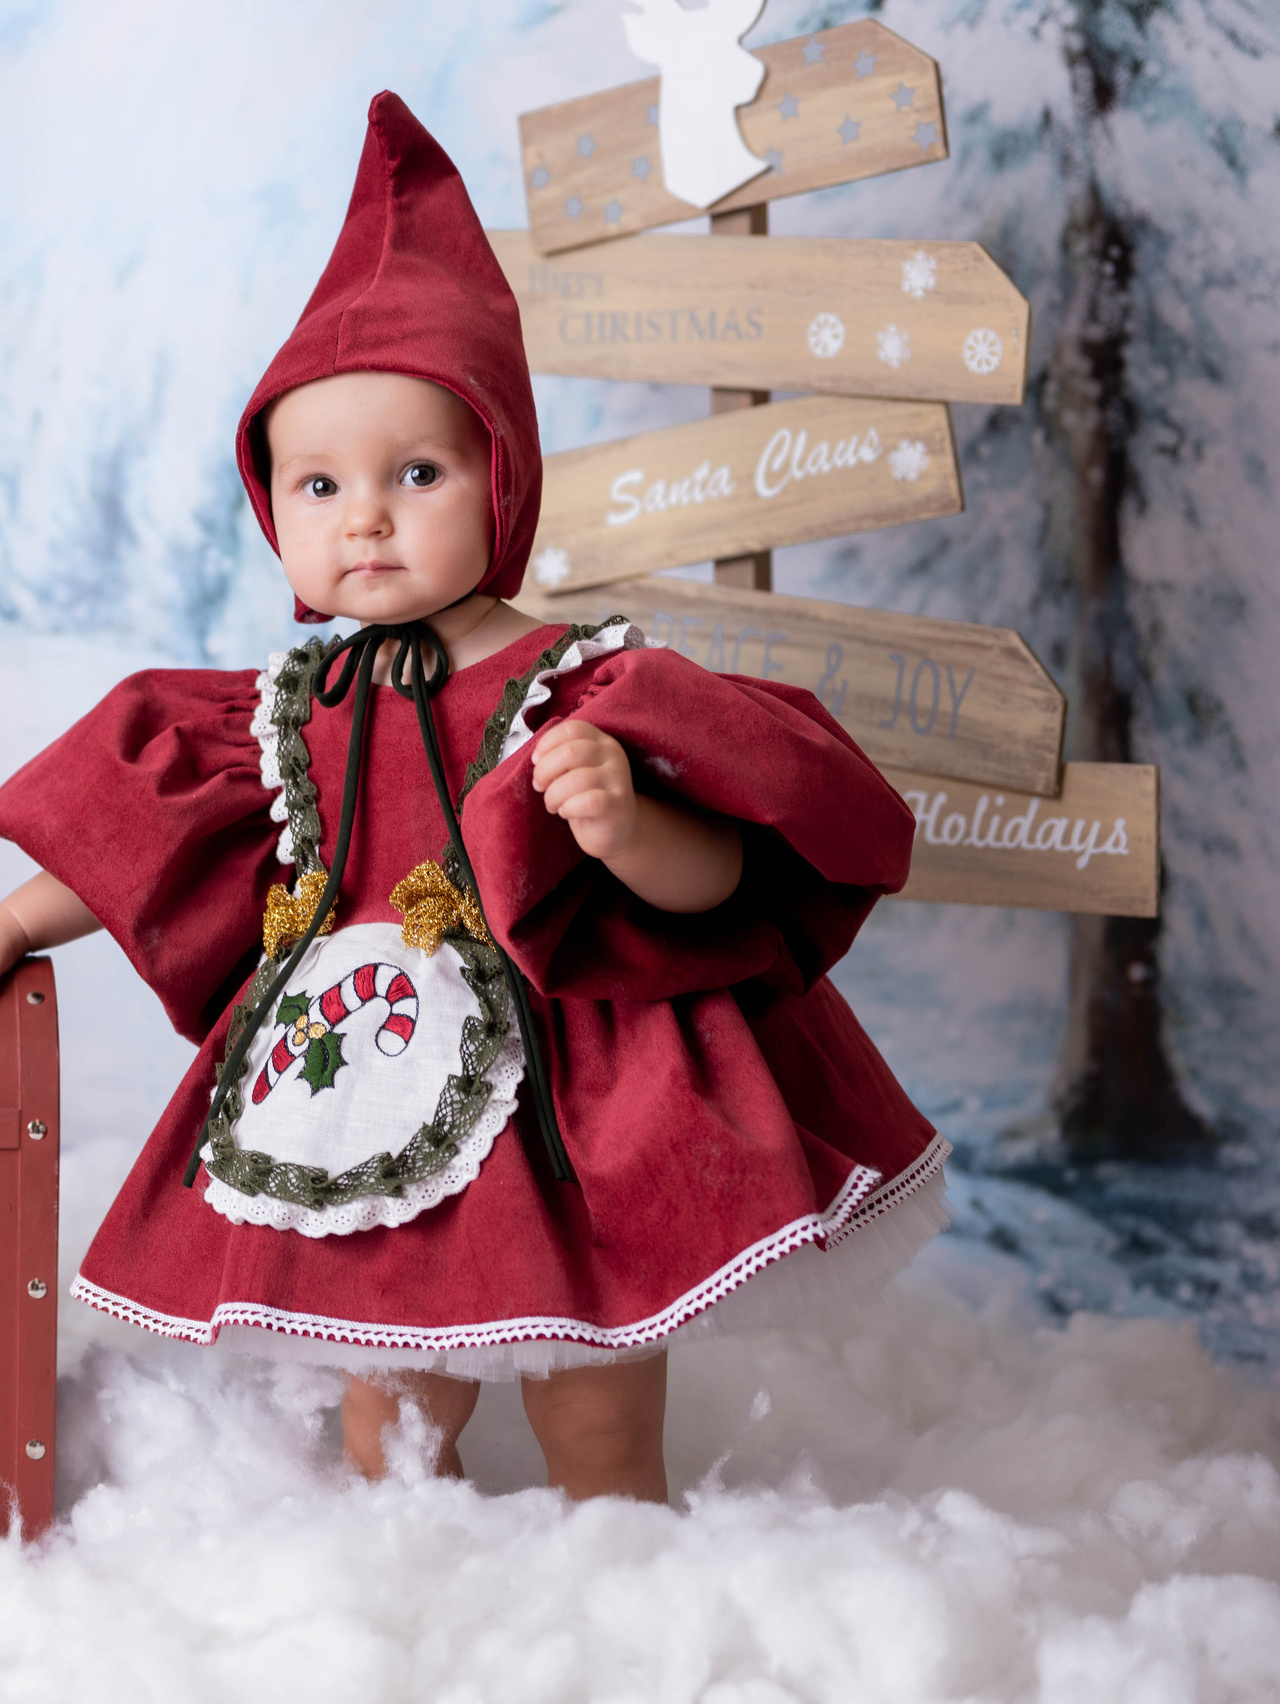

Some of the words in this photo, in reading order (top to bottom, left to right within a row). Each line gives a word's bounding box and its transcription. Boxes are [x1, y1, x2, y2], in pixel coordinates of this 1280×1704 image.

[558, 307, 765, 345] CHRISTMAS
[606, 459, 734, 526] Santa
[754, 427, 884, 498] Claus
[878, 653, 976, 741] JOY
[904, 789, 1130, 871] Holidays
